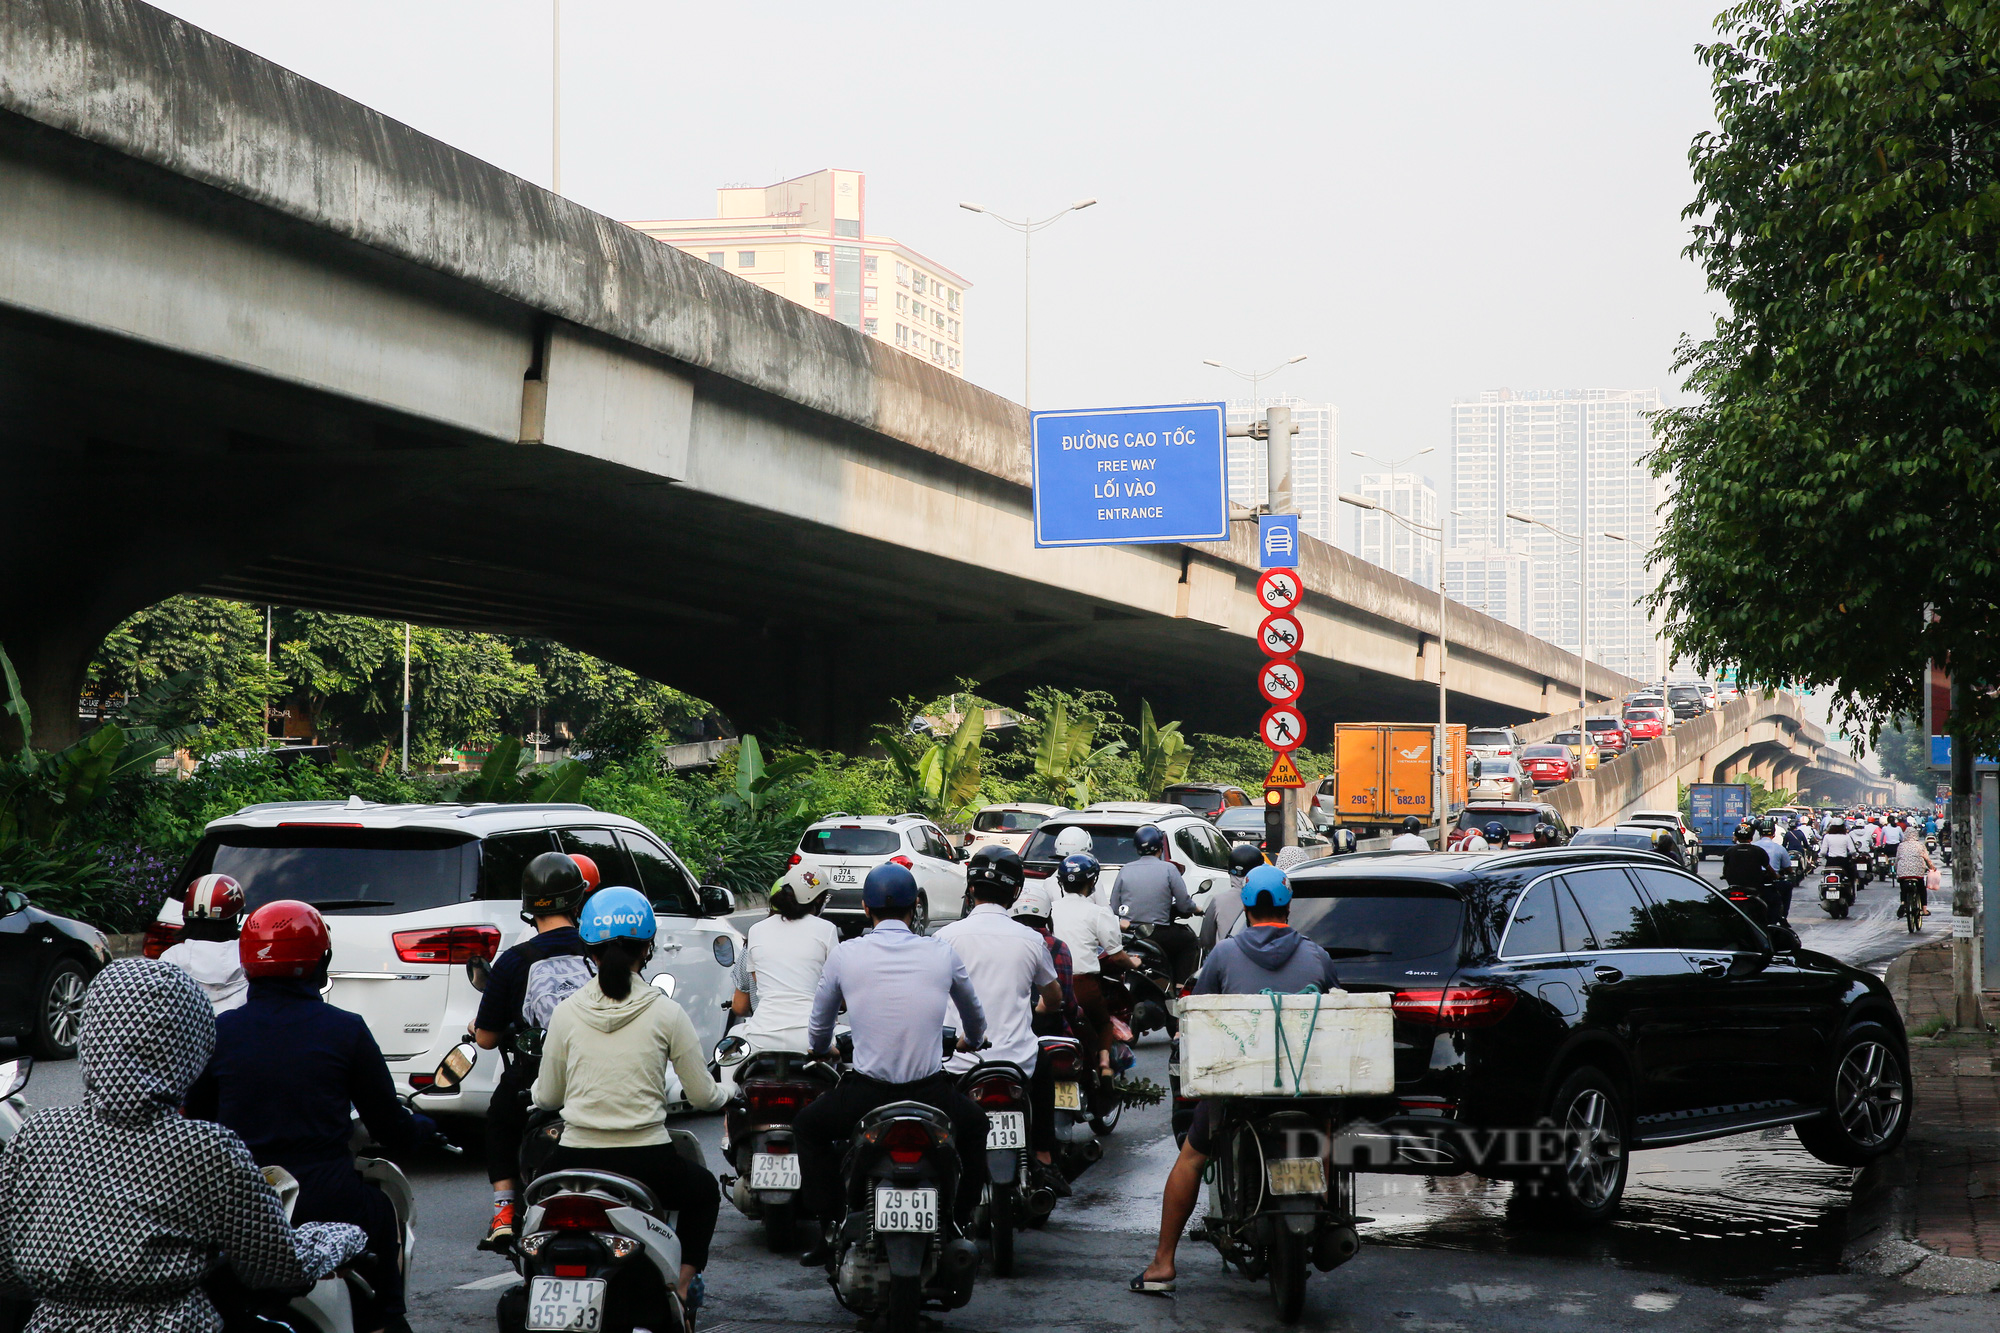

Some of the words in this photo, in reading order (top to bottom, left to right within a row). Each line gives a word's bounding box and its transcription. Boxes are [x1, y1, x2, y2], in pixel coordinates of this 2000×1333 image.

[1061, 429, 1119, 451] ĐƯỜNG
[1124, 432, 1157, 448] CAO
[1162, 425, 1196, 446] TỐC
[1097, 460, 1128, 473] FREE
[1131, 458, 1157, 471] WAY
[1094, 477, 1119, 499] LỐI
[1124, 477, 1156, 498] VÀO
[1098, 506, 1163, 521] ENTRANCE
[1279, 765, 1289, 774] ĐI
[1270, 774, 1298, 785] CHẬM
[1352, 795, 1367, 804] 29C
[1397, 795, 1426, 805] 682.03
[593, 914, 643, 927] coway
[760, 1156, 794, 1171] 29-C1
[754, 1172, 798, 1187] 242.70
[886, 1191, 928, 1209] 29-G1
[880, 1211, 933, 1229] 090.96
[540, 1281, 594, 1304] 29-L1
